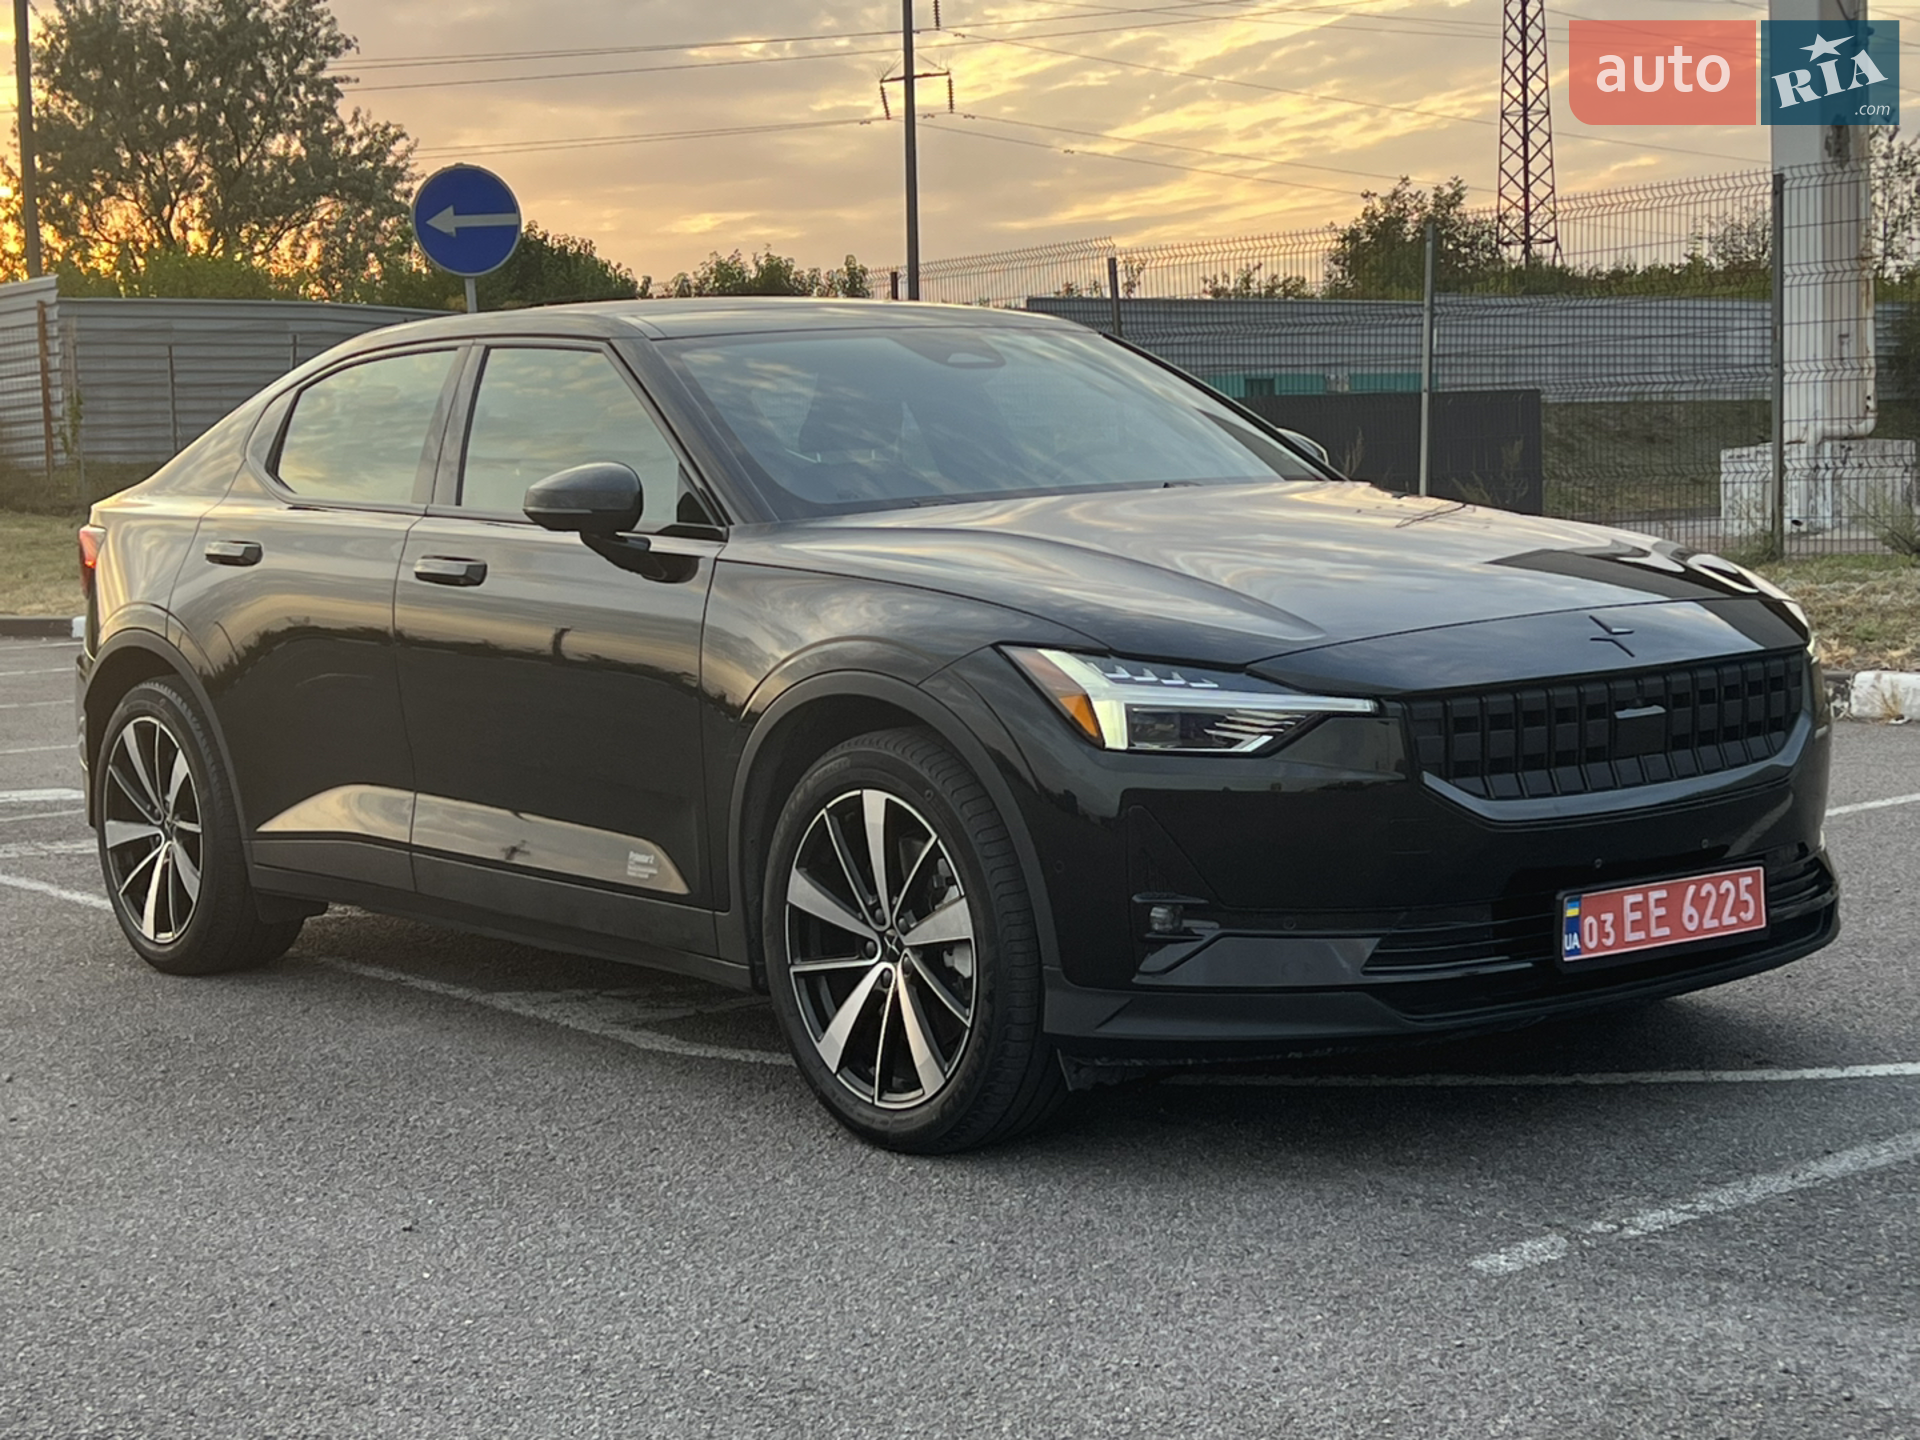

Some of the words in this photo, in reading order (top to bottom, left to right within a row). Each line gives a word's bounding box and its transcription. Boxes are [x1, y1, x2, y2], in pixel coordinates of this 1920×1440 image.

[1583, 912, 1616, 949] 03
[1623, 889, 1671, 942] EE
[1682, 876, 1756, 932] 6225
[1564, 933, 1581, 950] UA
